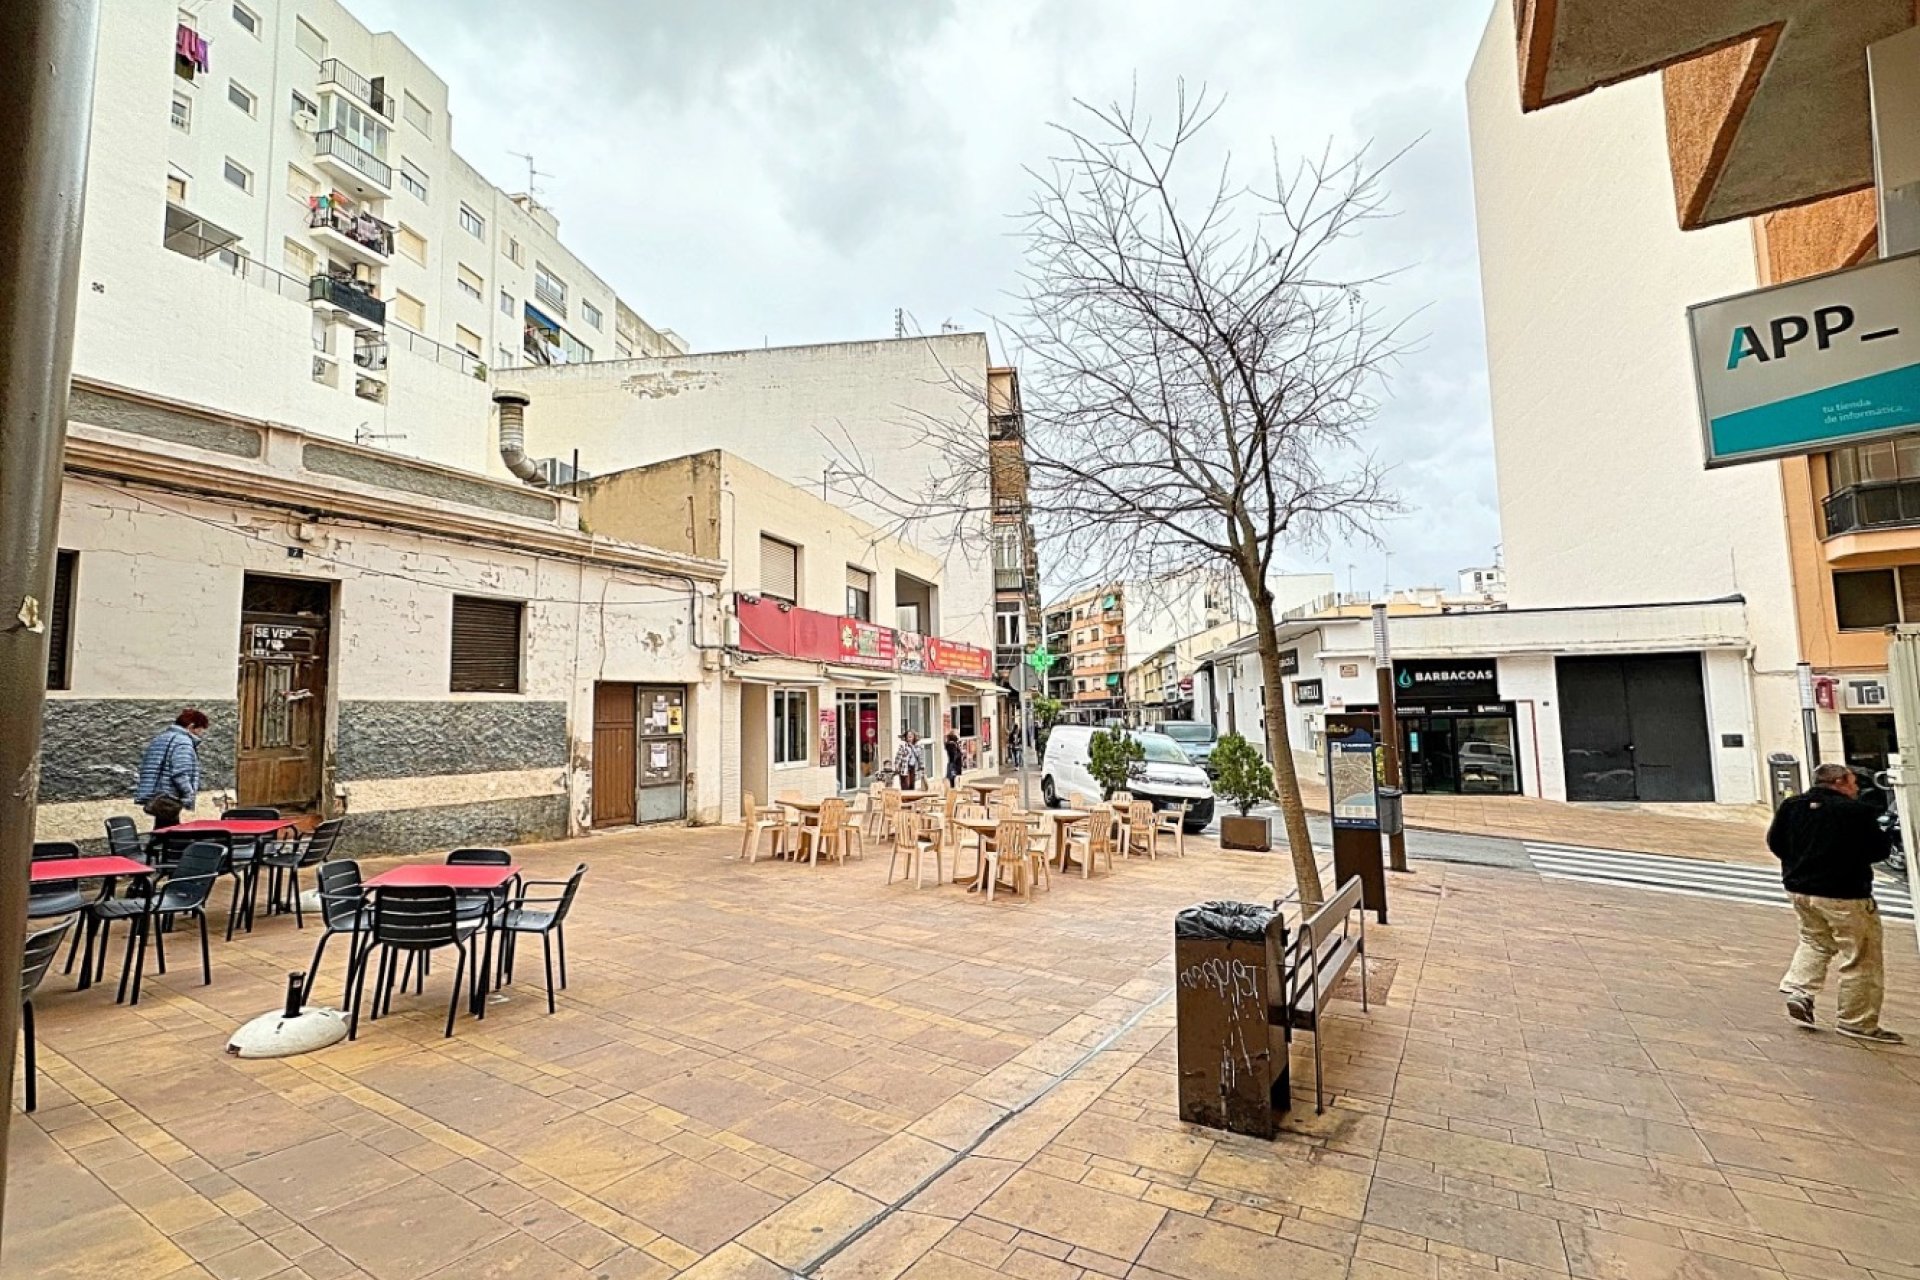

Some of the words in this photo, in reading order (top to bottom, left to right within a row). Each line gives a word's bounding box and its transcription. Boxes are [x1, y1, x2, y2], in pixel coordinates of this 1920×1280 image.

[1836, 398, 1871, 411] tienda
[1824, 415, 1837, 424] de
[255, 627, 269, 638] SE
[1415, 670, 1494, 681] BARBACOAS
